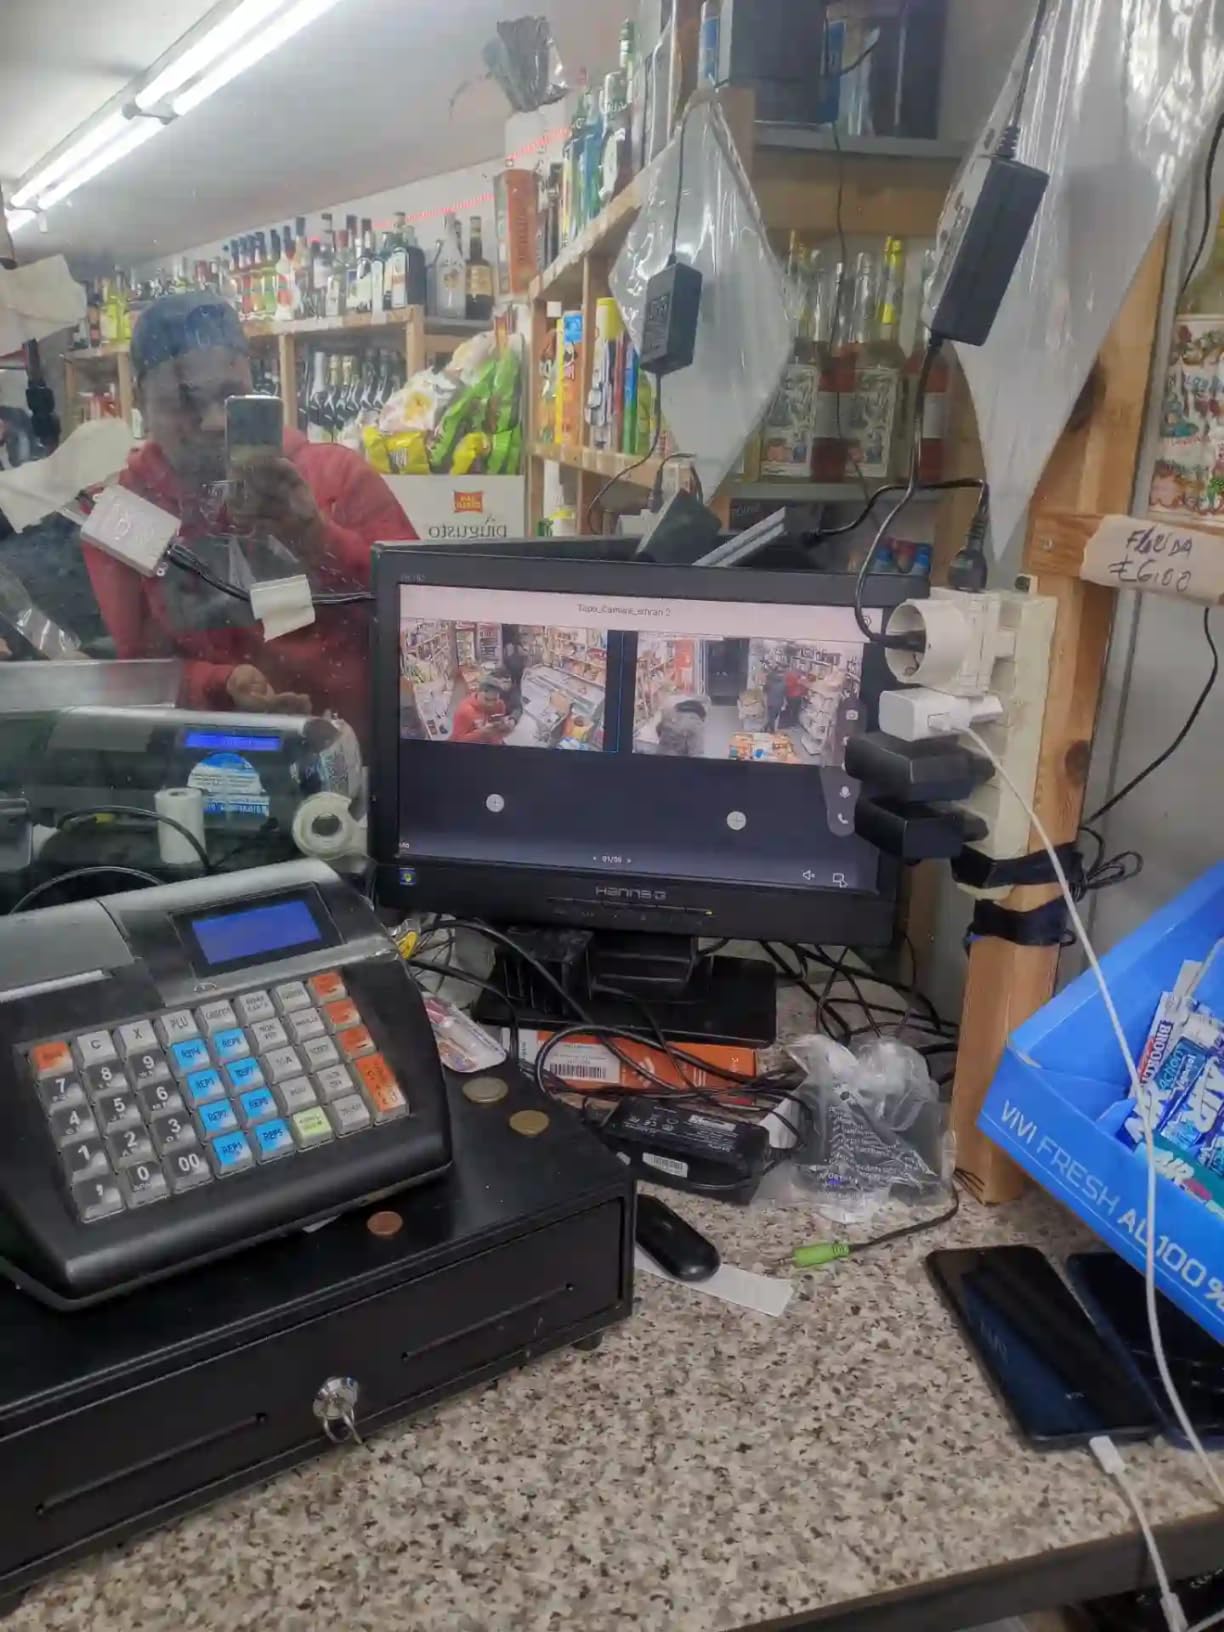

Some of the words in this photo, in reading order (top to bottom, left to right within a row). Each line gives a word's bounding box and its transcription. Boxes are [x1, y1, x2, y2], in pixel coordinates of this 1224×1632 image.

[143, 1055, 155, 1070] 9
[101, 1066, 112, 1081] 8
[55, 1077, 66, 1093] 7
[156, 1086, 168, 1101] 6
[114, 1098, 126, 1113] 5
[69, 1111, 80, 1126] 4
[168, 1118, 181, 1134] 3
[125, 1131, 138, 1148] 2
[77, 1145, 91, 1161] 1
[177, 1152, 201, 1172] 00
[137, 1165, 150, 1182] 0
[1000, 1099, 1038, 1145] VIVI
[1036, 1135, 1121, 1217] FRESH
[1117, 1208, 1149, 1247] AL
[1155, 1235, 1208, 1288] 100
